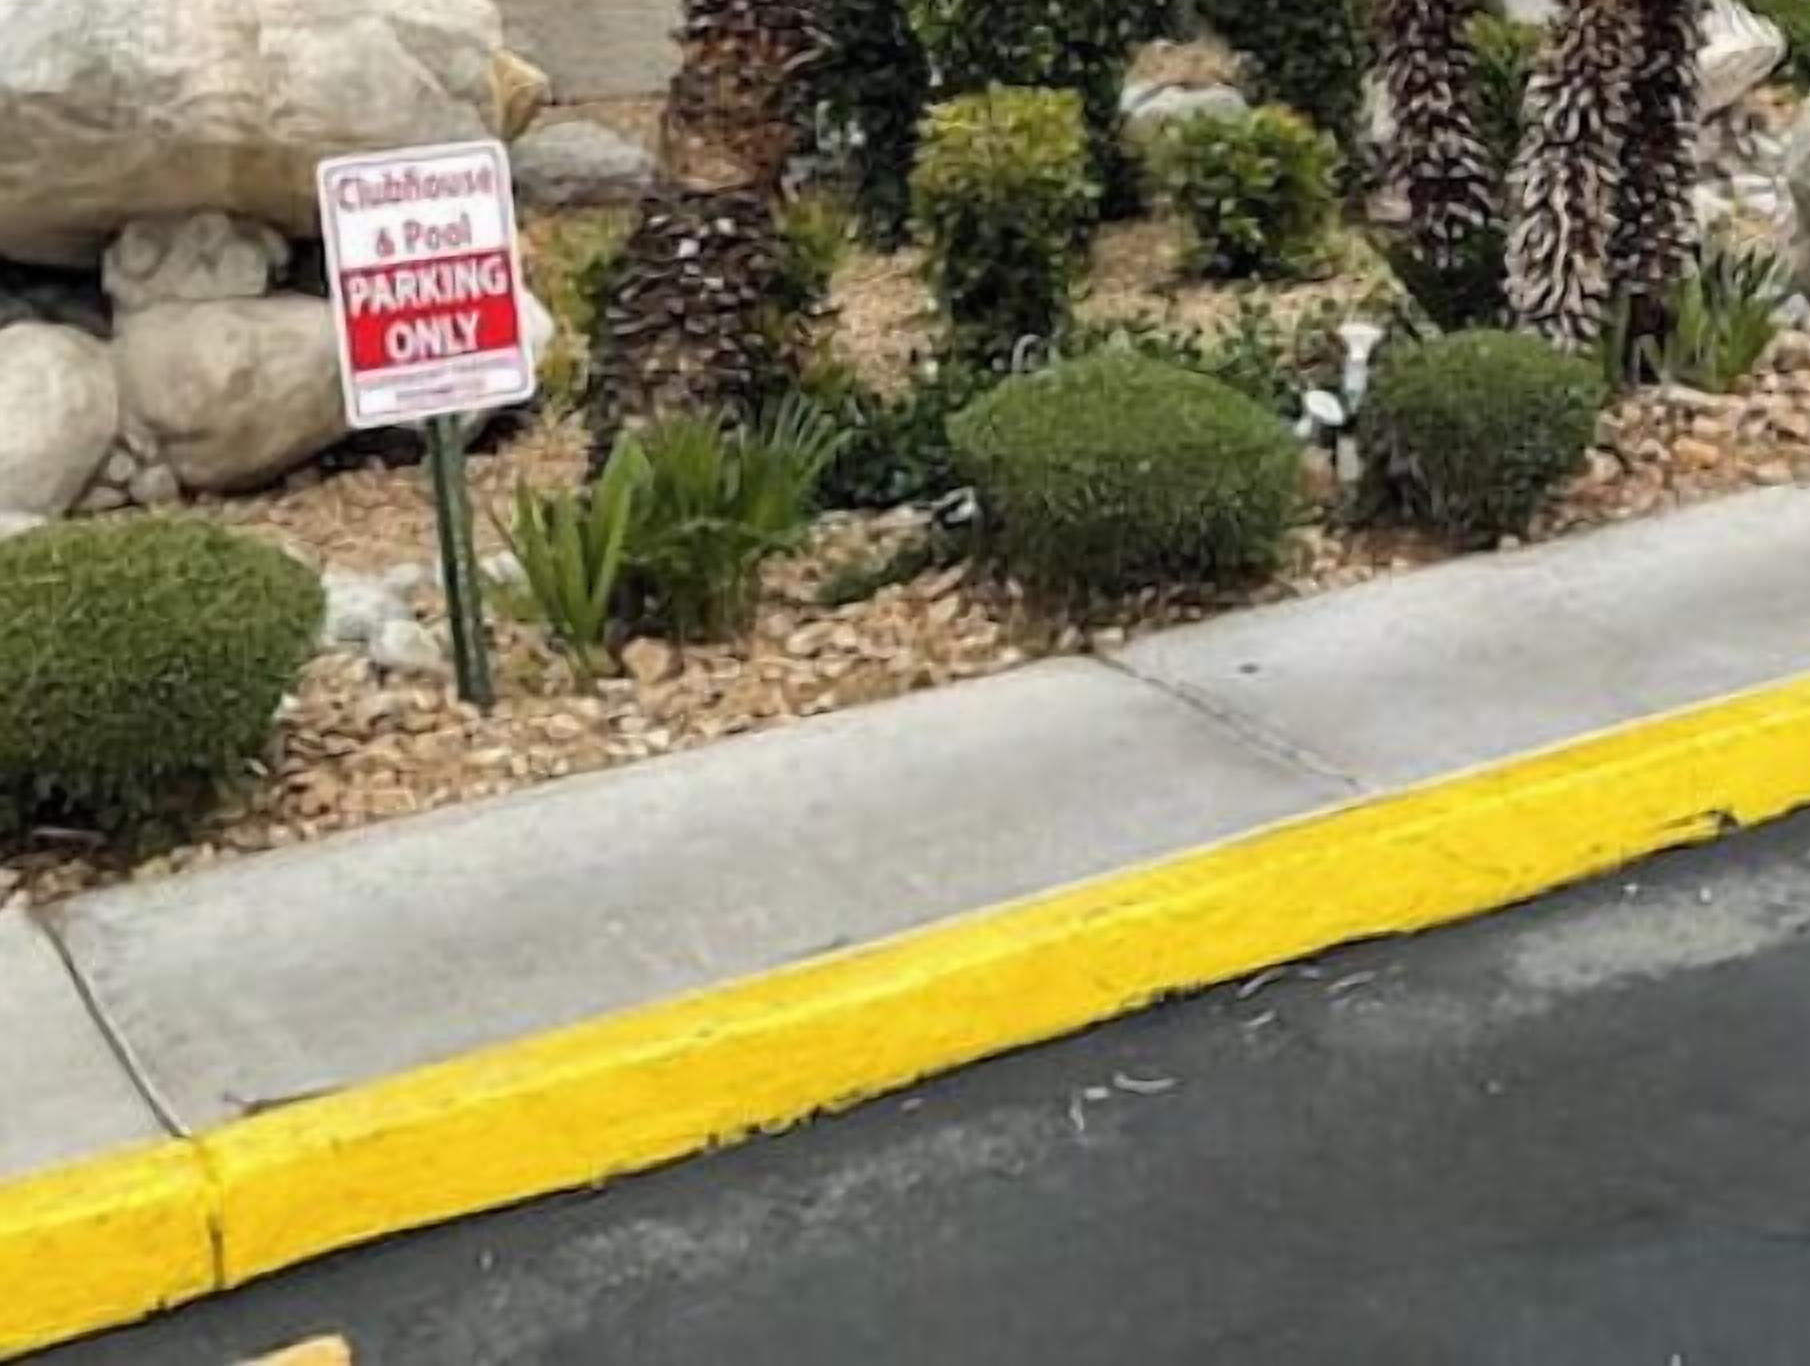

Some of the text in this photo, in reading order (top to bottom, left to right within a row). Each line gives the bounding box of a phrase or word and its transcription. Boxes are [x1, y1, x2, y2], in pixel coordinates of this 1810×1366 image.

[338, 166, 493, 210] Clubhouse
[404, 211, 473, 251] Pool
[347, 257, 508, 318] PARKING
[386, 309, 481, 361] ONLY
